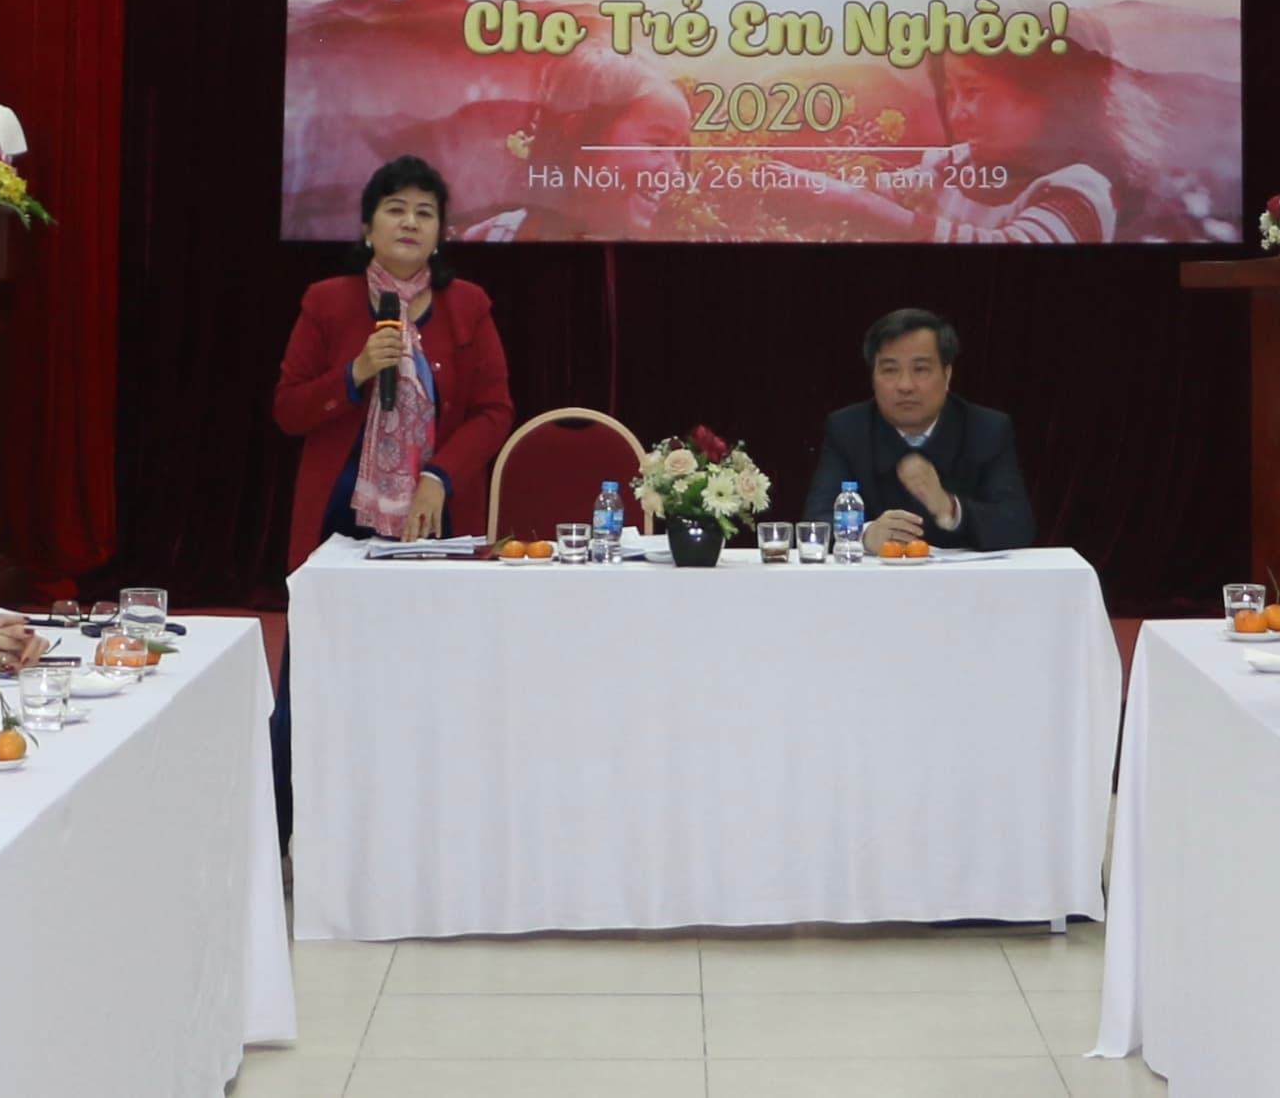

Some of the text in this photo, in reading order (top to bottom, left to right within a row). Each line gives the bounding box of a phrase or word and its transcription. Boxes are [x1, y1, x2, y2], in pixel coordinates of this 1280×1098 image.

[728, 0, 833, 57] Em
[690, 82, 844, 135] 2020
[528, 165, 1008, 194] Hà Nội, ngày 26 tháng 12 năm 2019
